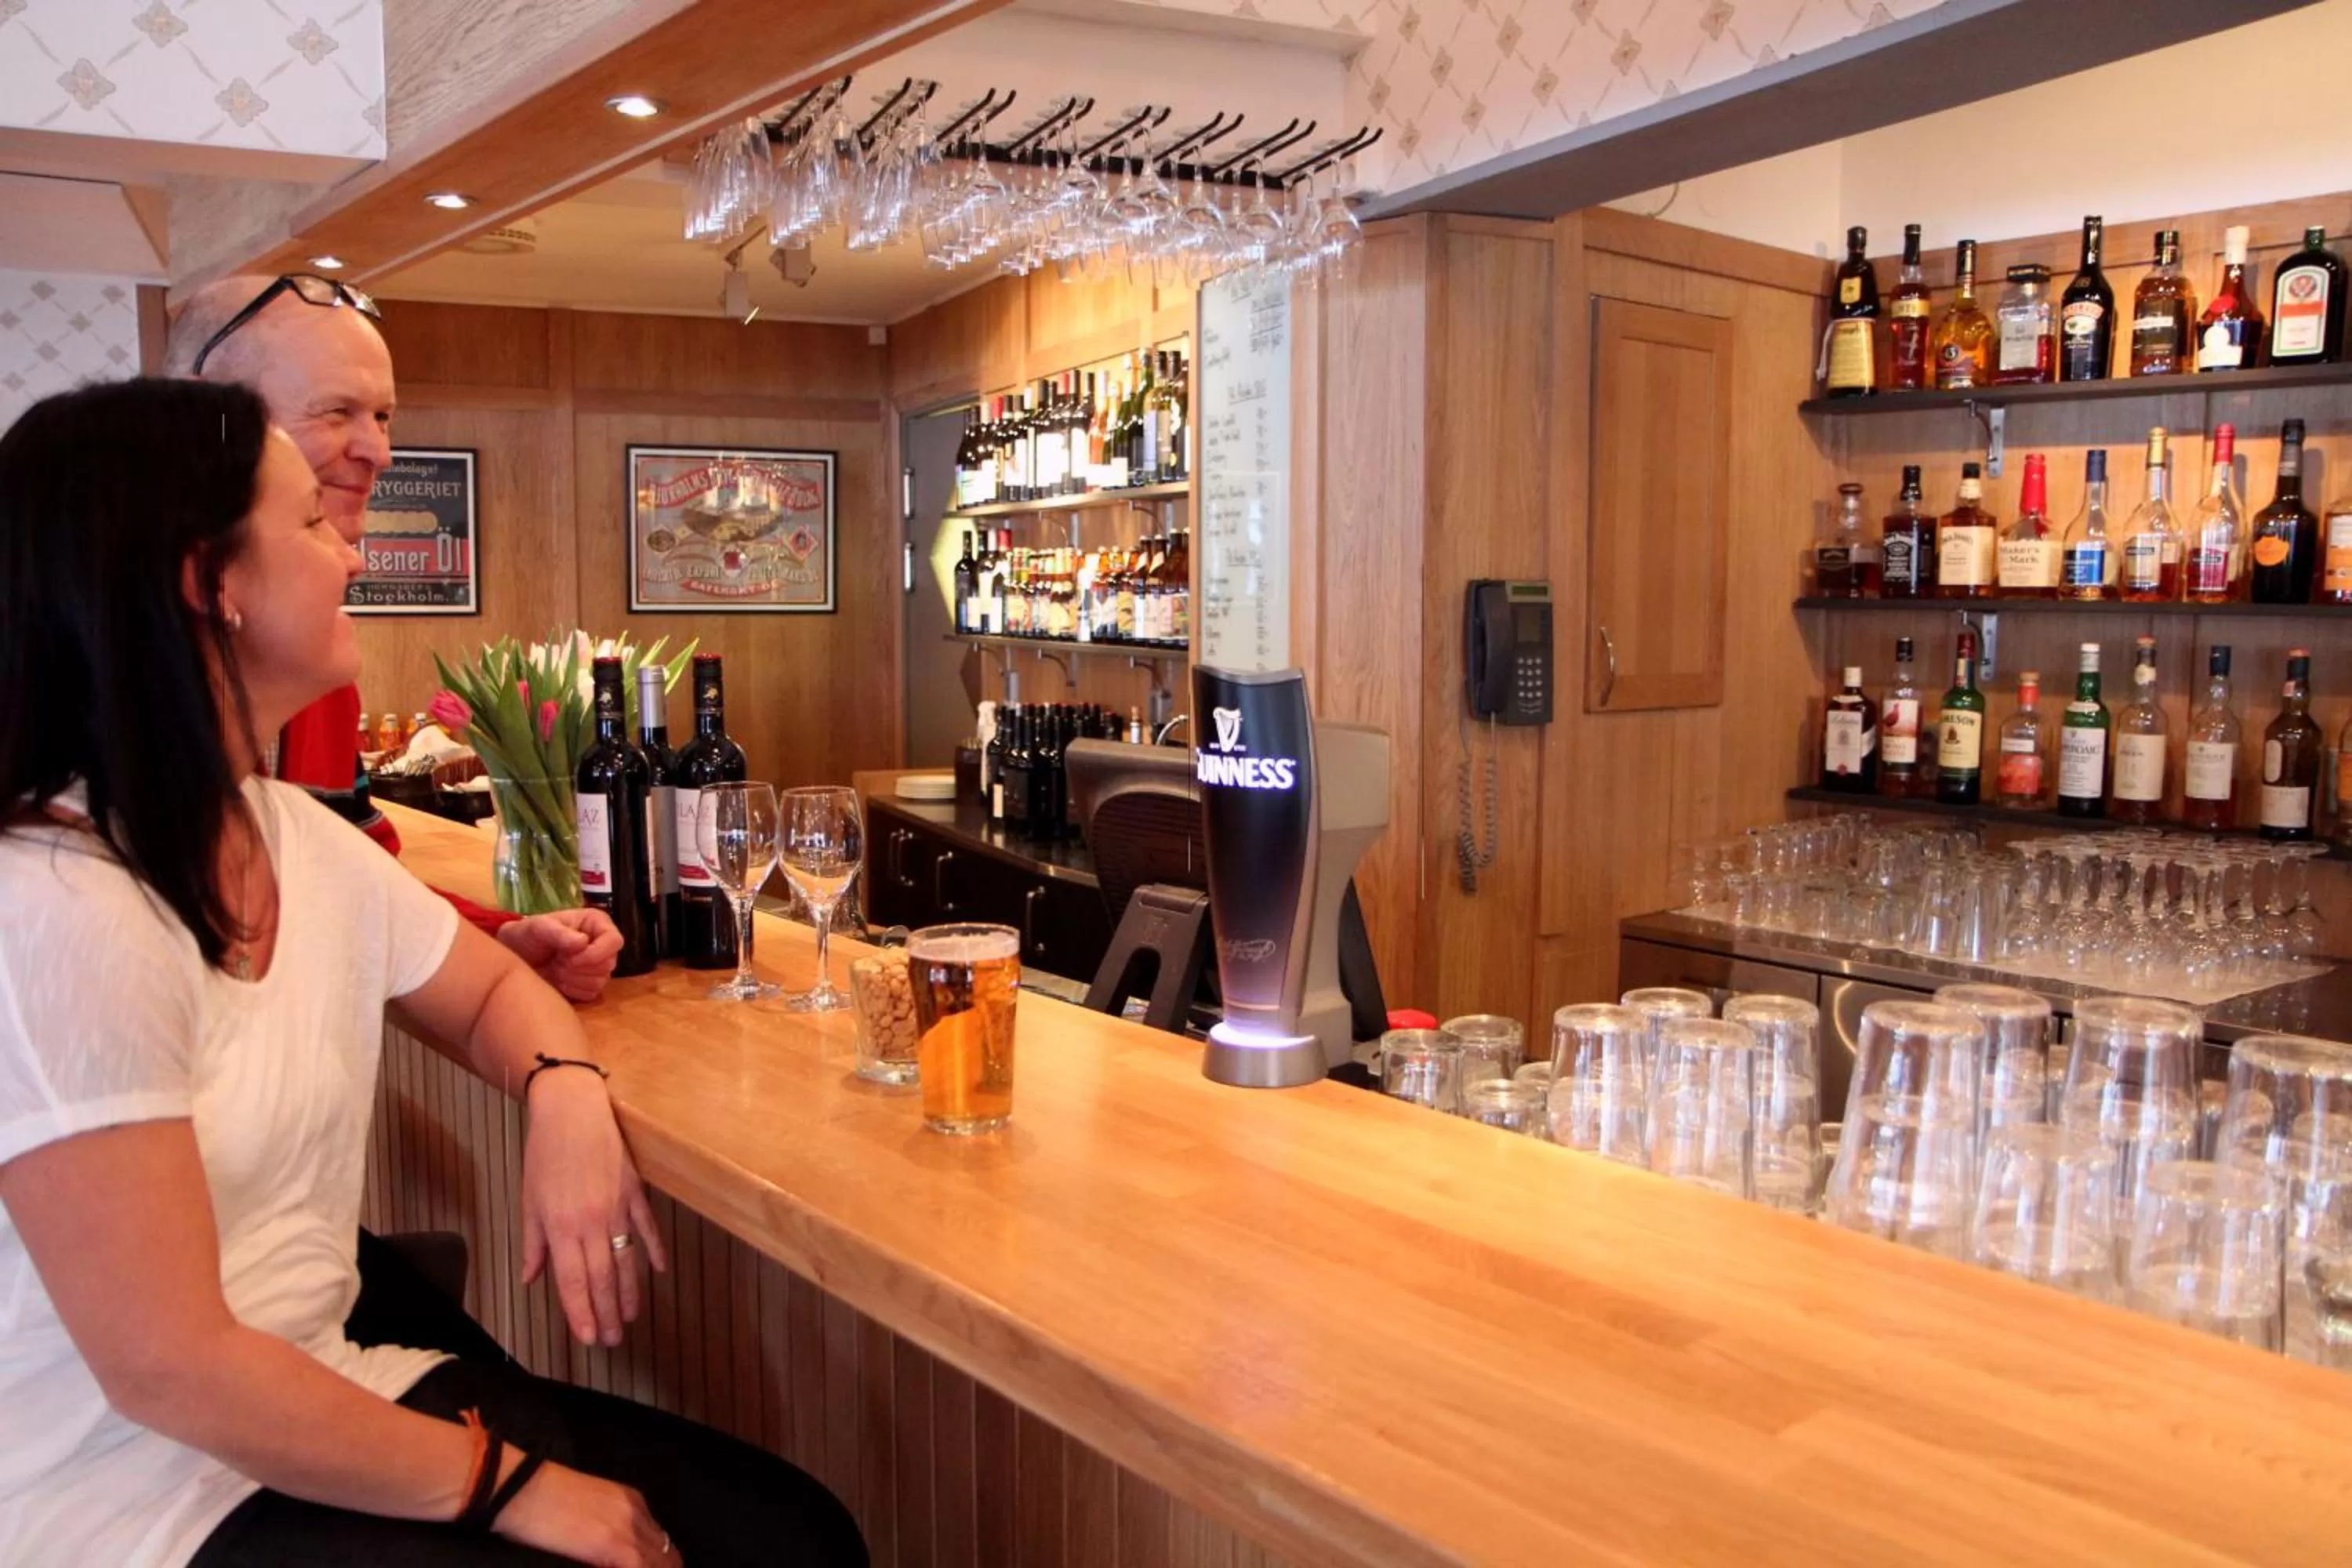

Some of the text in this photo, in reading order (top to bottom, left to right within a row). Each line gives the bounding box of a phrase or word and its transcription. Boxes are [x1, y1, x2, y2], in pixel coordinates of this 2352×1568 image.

[372, 480, 462, 499] RYGGERIET
[360, 526, 462, 573] lsener Öl
